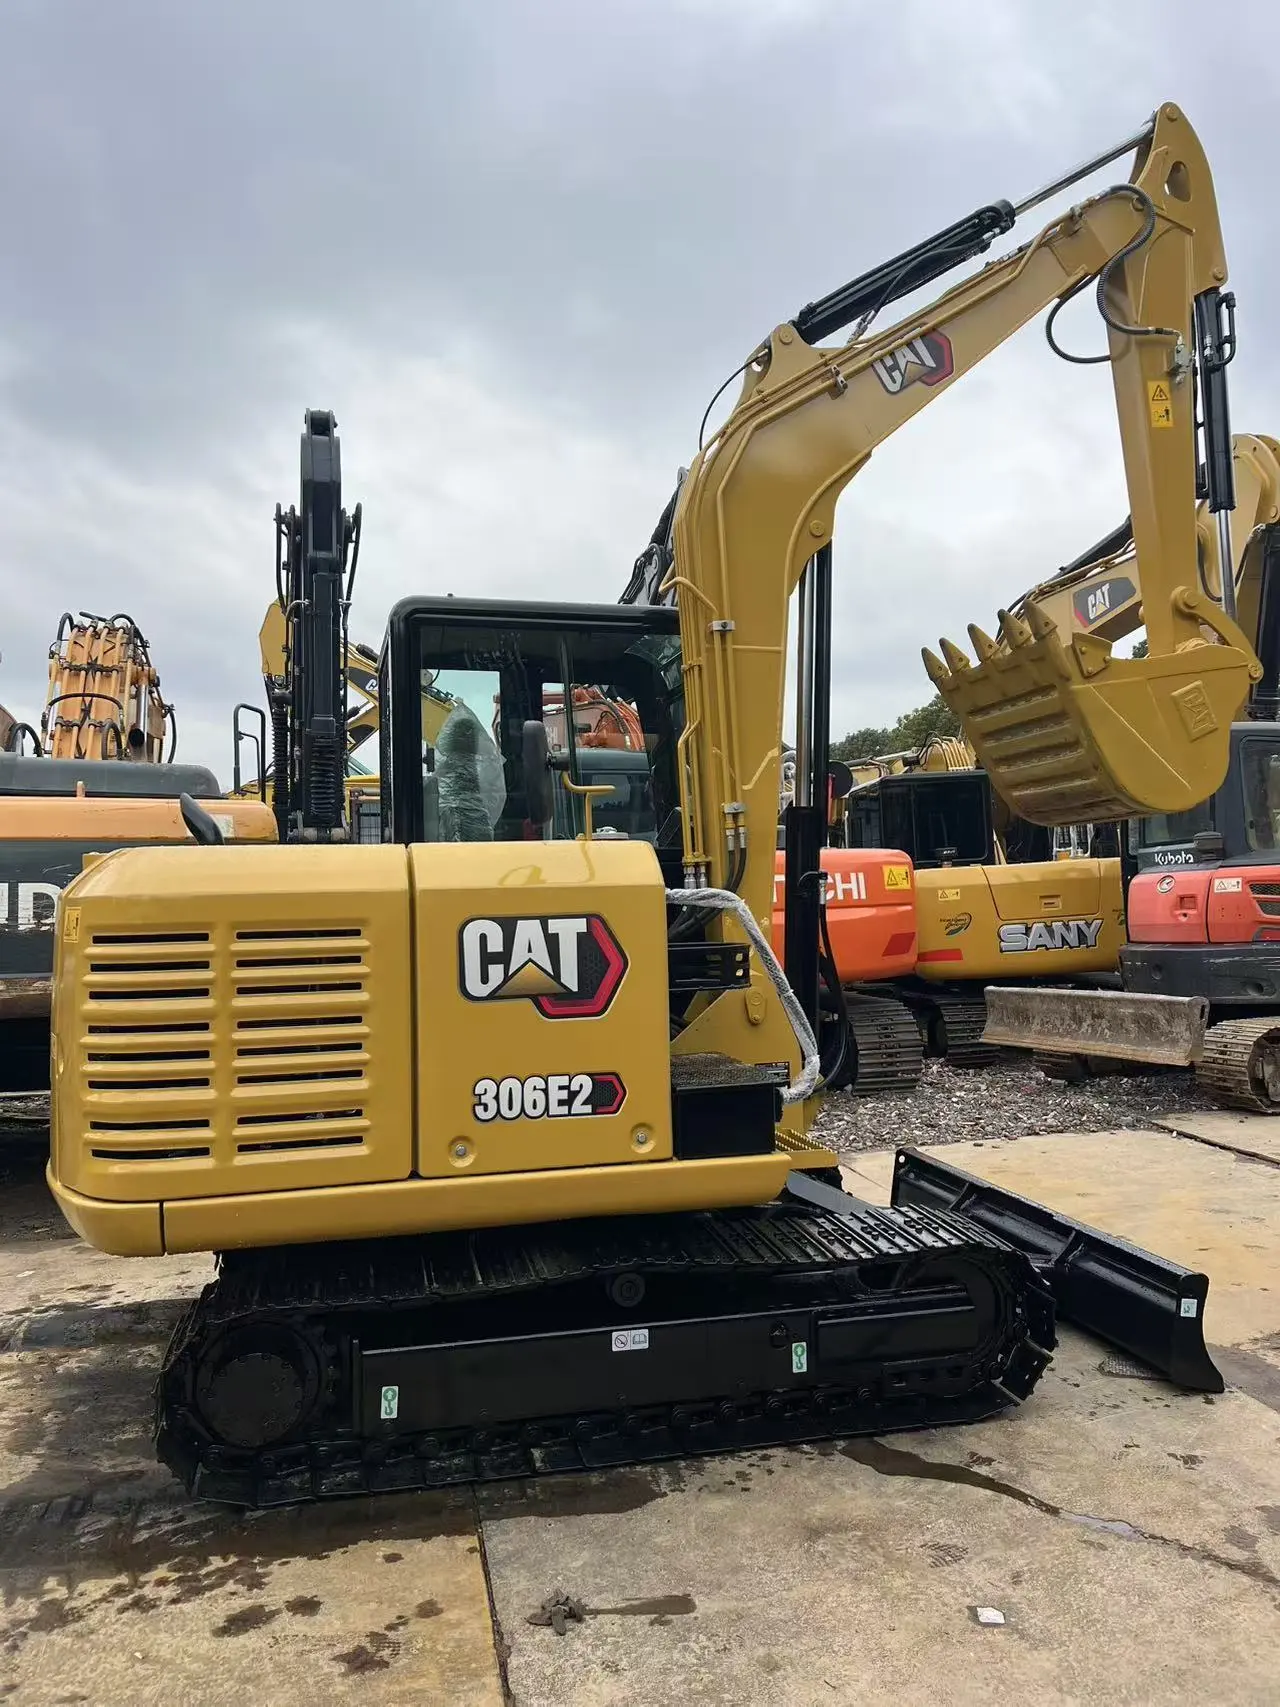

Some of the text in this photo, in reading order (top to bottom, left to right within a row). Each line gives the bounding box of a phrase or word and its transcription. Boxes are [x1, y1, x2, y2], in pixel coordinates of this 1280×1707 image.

[1087, 582, 1110, 620] CAT
[1154, 851, 1194, 866] Kubota
[998, 918, 1104, 953] SANY
[462, 917, 588, 998] CAT
[473, 1073, 593, 1121] 306E2
